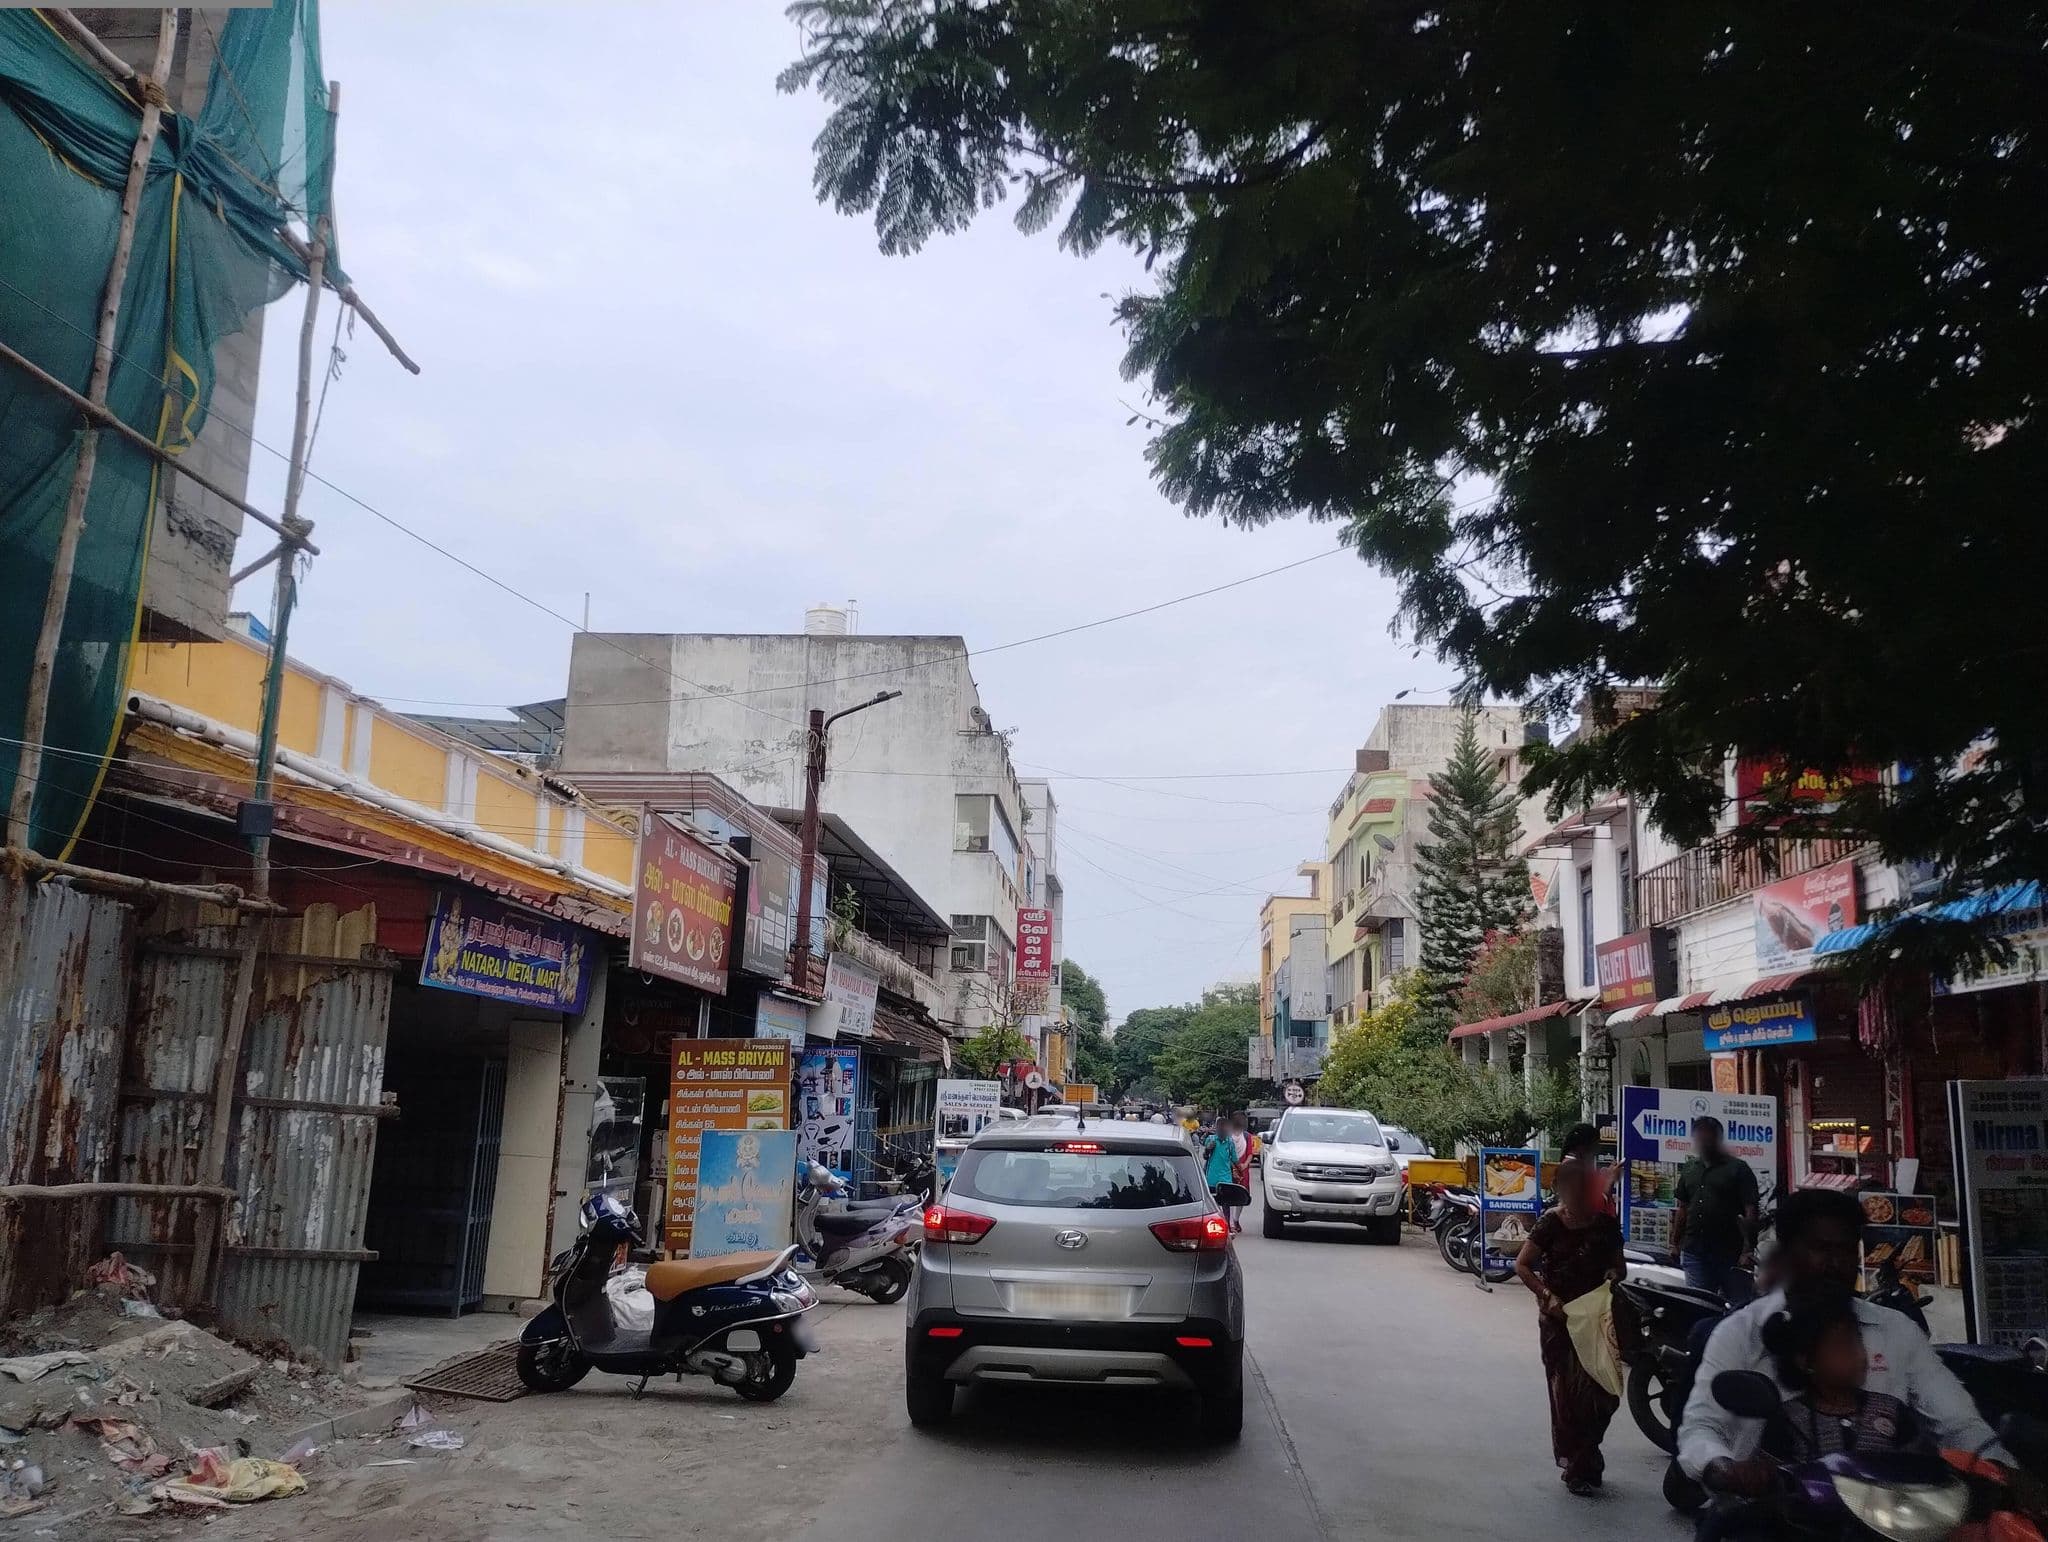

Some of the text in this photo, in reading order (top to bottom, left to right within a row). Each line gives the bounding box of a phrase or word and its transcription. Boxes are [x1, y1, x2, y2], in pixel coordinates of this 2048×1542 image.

[664, 837, 674, 858] AL
[680, 844, 697, 874] MASS
[461, 950, 561, 991] NATARAJ METAL MART
[678, 1051, 693, 1066] AL
[703, 1051, 735, 1066] MASS
[738, 1051, 784, 1066] BRIYANI
[1643, 1113, 1686, 1137] Nirma
[1727, 1120, 1773, 1144] House
[1973, 1120, 2039, 1150] Nirma
[1489, 1200, 1534, 1210] SANDWICH
